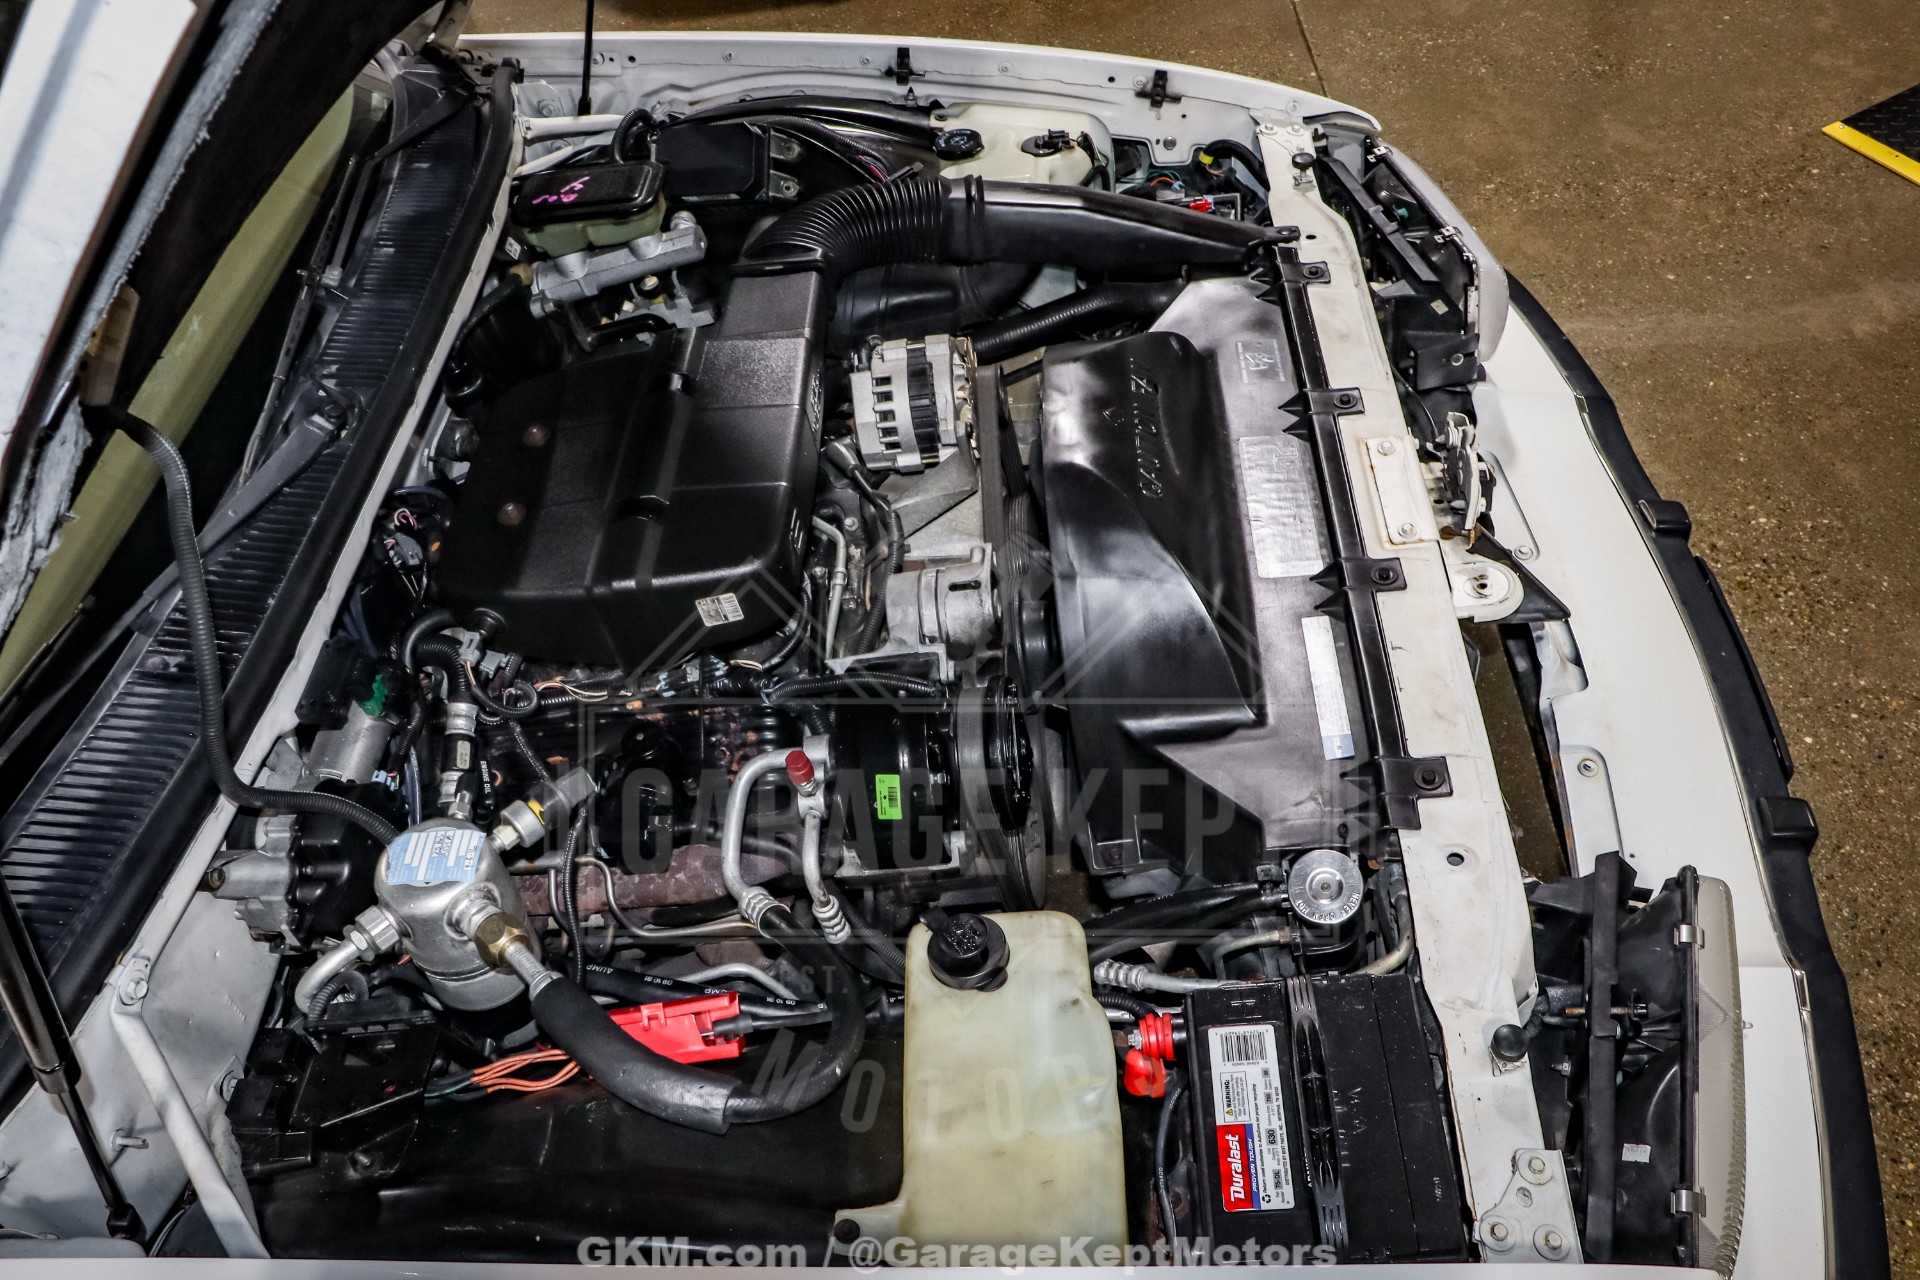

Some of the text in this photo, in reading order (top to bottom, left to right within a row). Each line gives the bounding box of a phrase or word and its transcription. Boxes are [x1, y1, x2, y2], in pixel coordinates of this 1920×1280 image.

[480, 760, 492, 794] ENGINE OIL
[1341, 892, 1360, 916] NEVER
[1268, 1130, 1276, 1144] 630
[1225, 1134, 1245, 1202] Duralast
